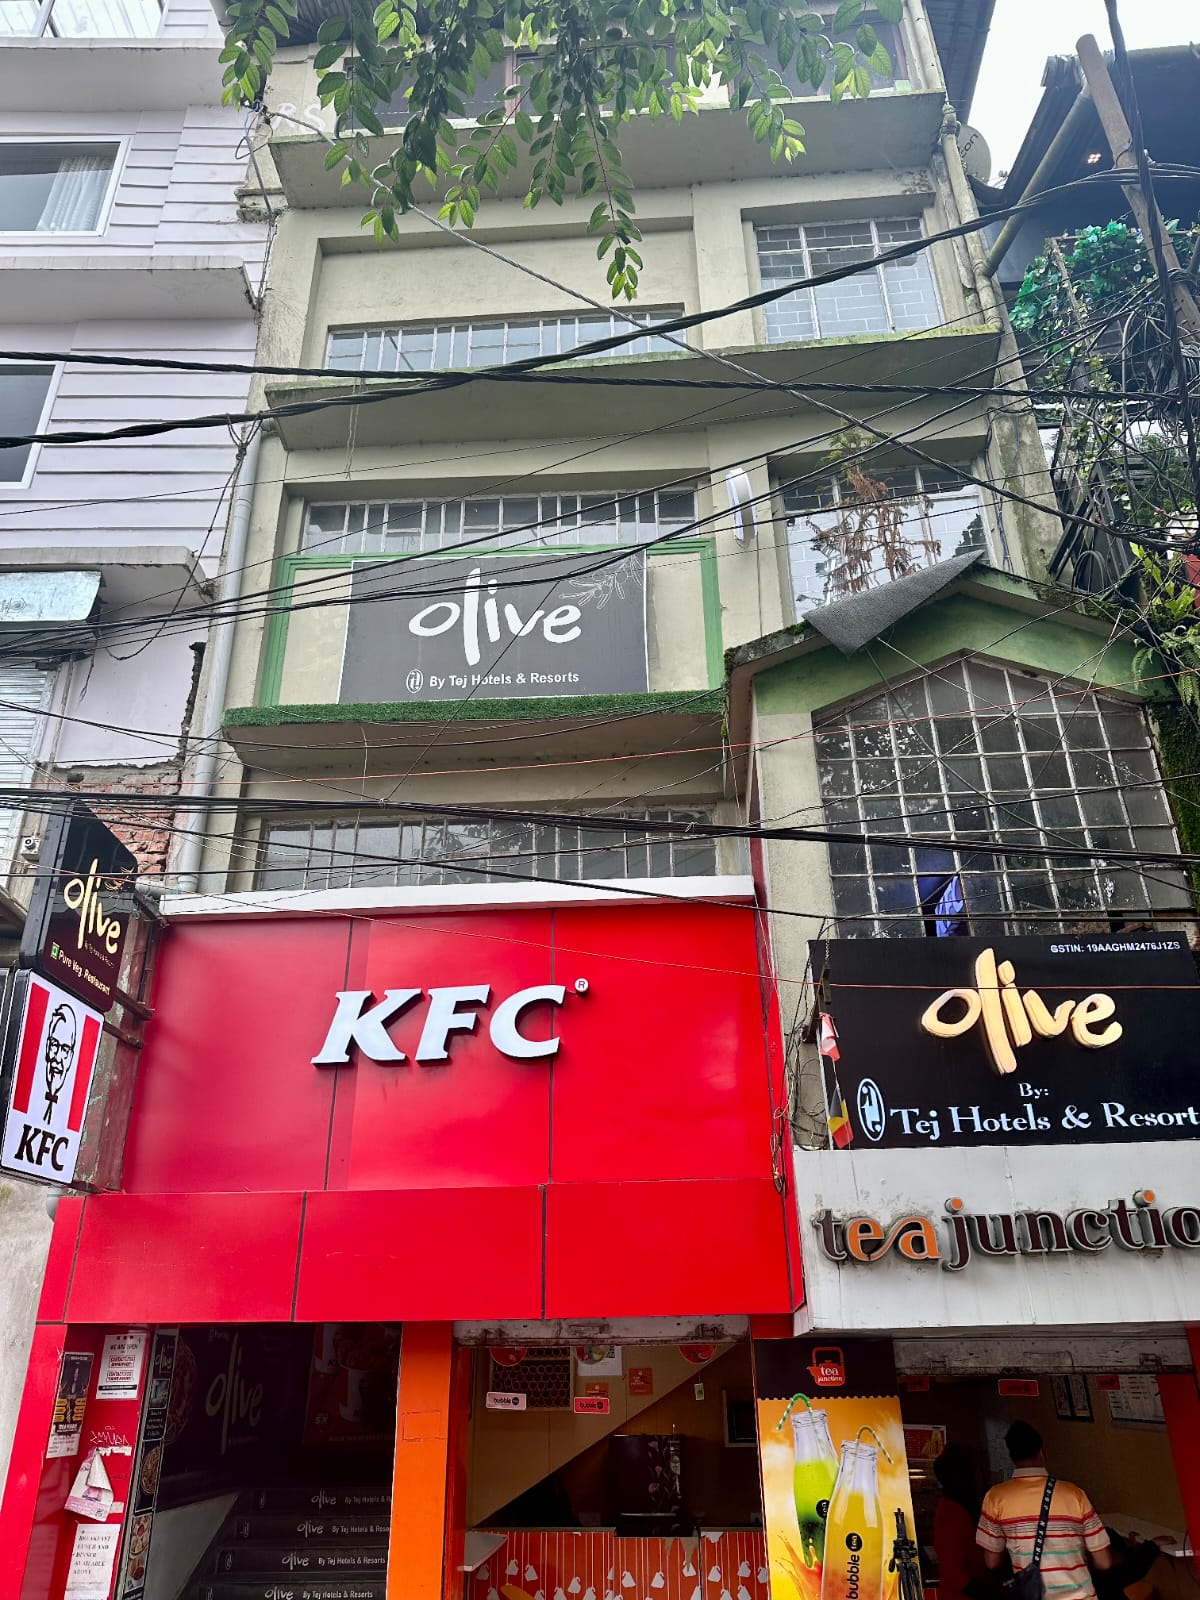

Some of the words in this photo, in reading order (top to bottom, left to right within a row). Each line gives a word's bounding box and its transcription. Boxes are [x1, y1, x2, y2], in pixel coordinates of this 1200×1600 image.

[408, 567, 582, 667] olive
[429, 675, 446, 690] By
[449, 674, 468, 689] Tej
[471, 673, 513, 686] Hotels
[515, 674, 527, 685] &
[530, 671, 580, 684] Resorts
[63, 858, 121, 954] olive
[1050, 943, 1085, 953] GSTIN:
[920, 946, 1124, 1076] olive
[310, 984, 566, 1065] KFC
[1018, 1082, 1050, 1100] By:
[889, 1107, 942, 1141] Tej
[947, 1102, 1051, 1133] Hotels
[1061, 1104, 1092, 1130] &
[14, 1123, 70, 1172] KFC
[820, 1364, 840, 1376] tea
[311, 1488, 337, 1510] olive
[297, 1519, 324, 1539] olive
[281, 1552, 310, 1572] olive
[845, 1553, 861, 1600] bubble
[264, 1585, 294, 1600] olive
